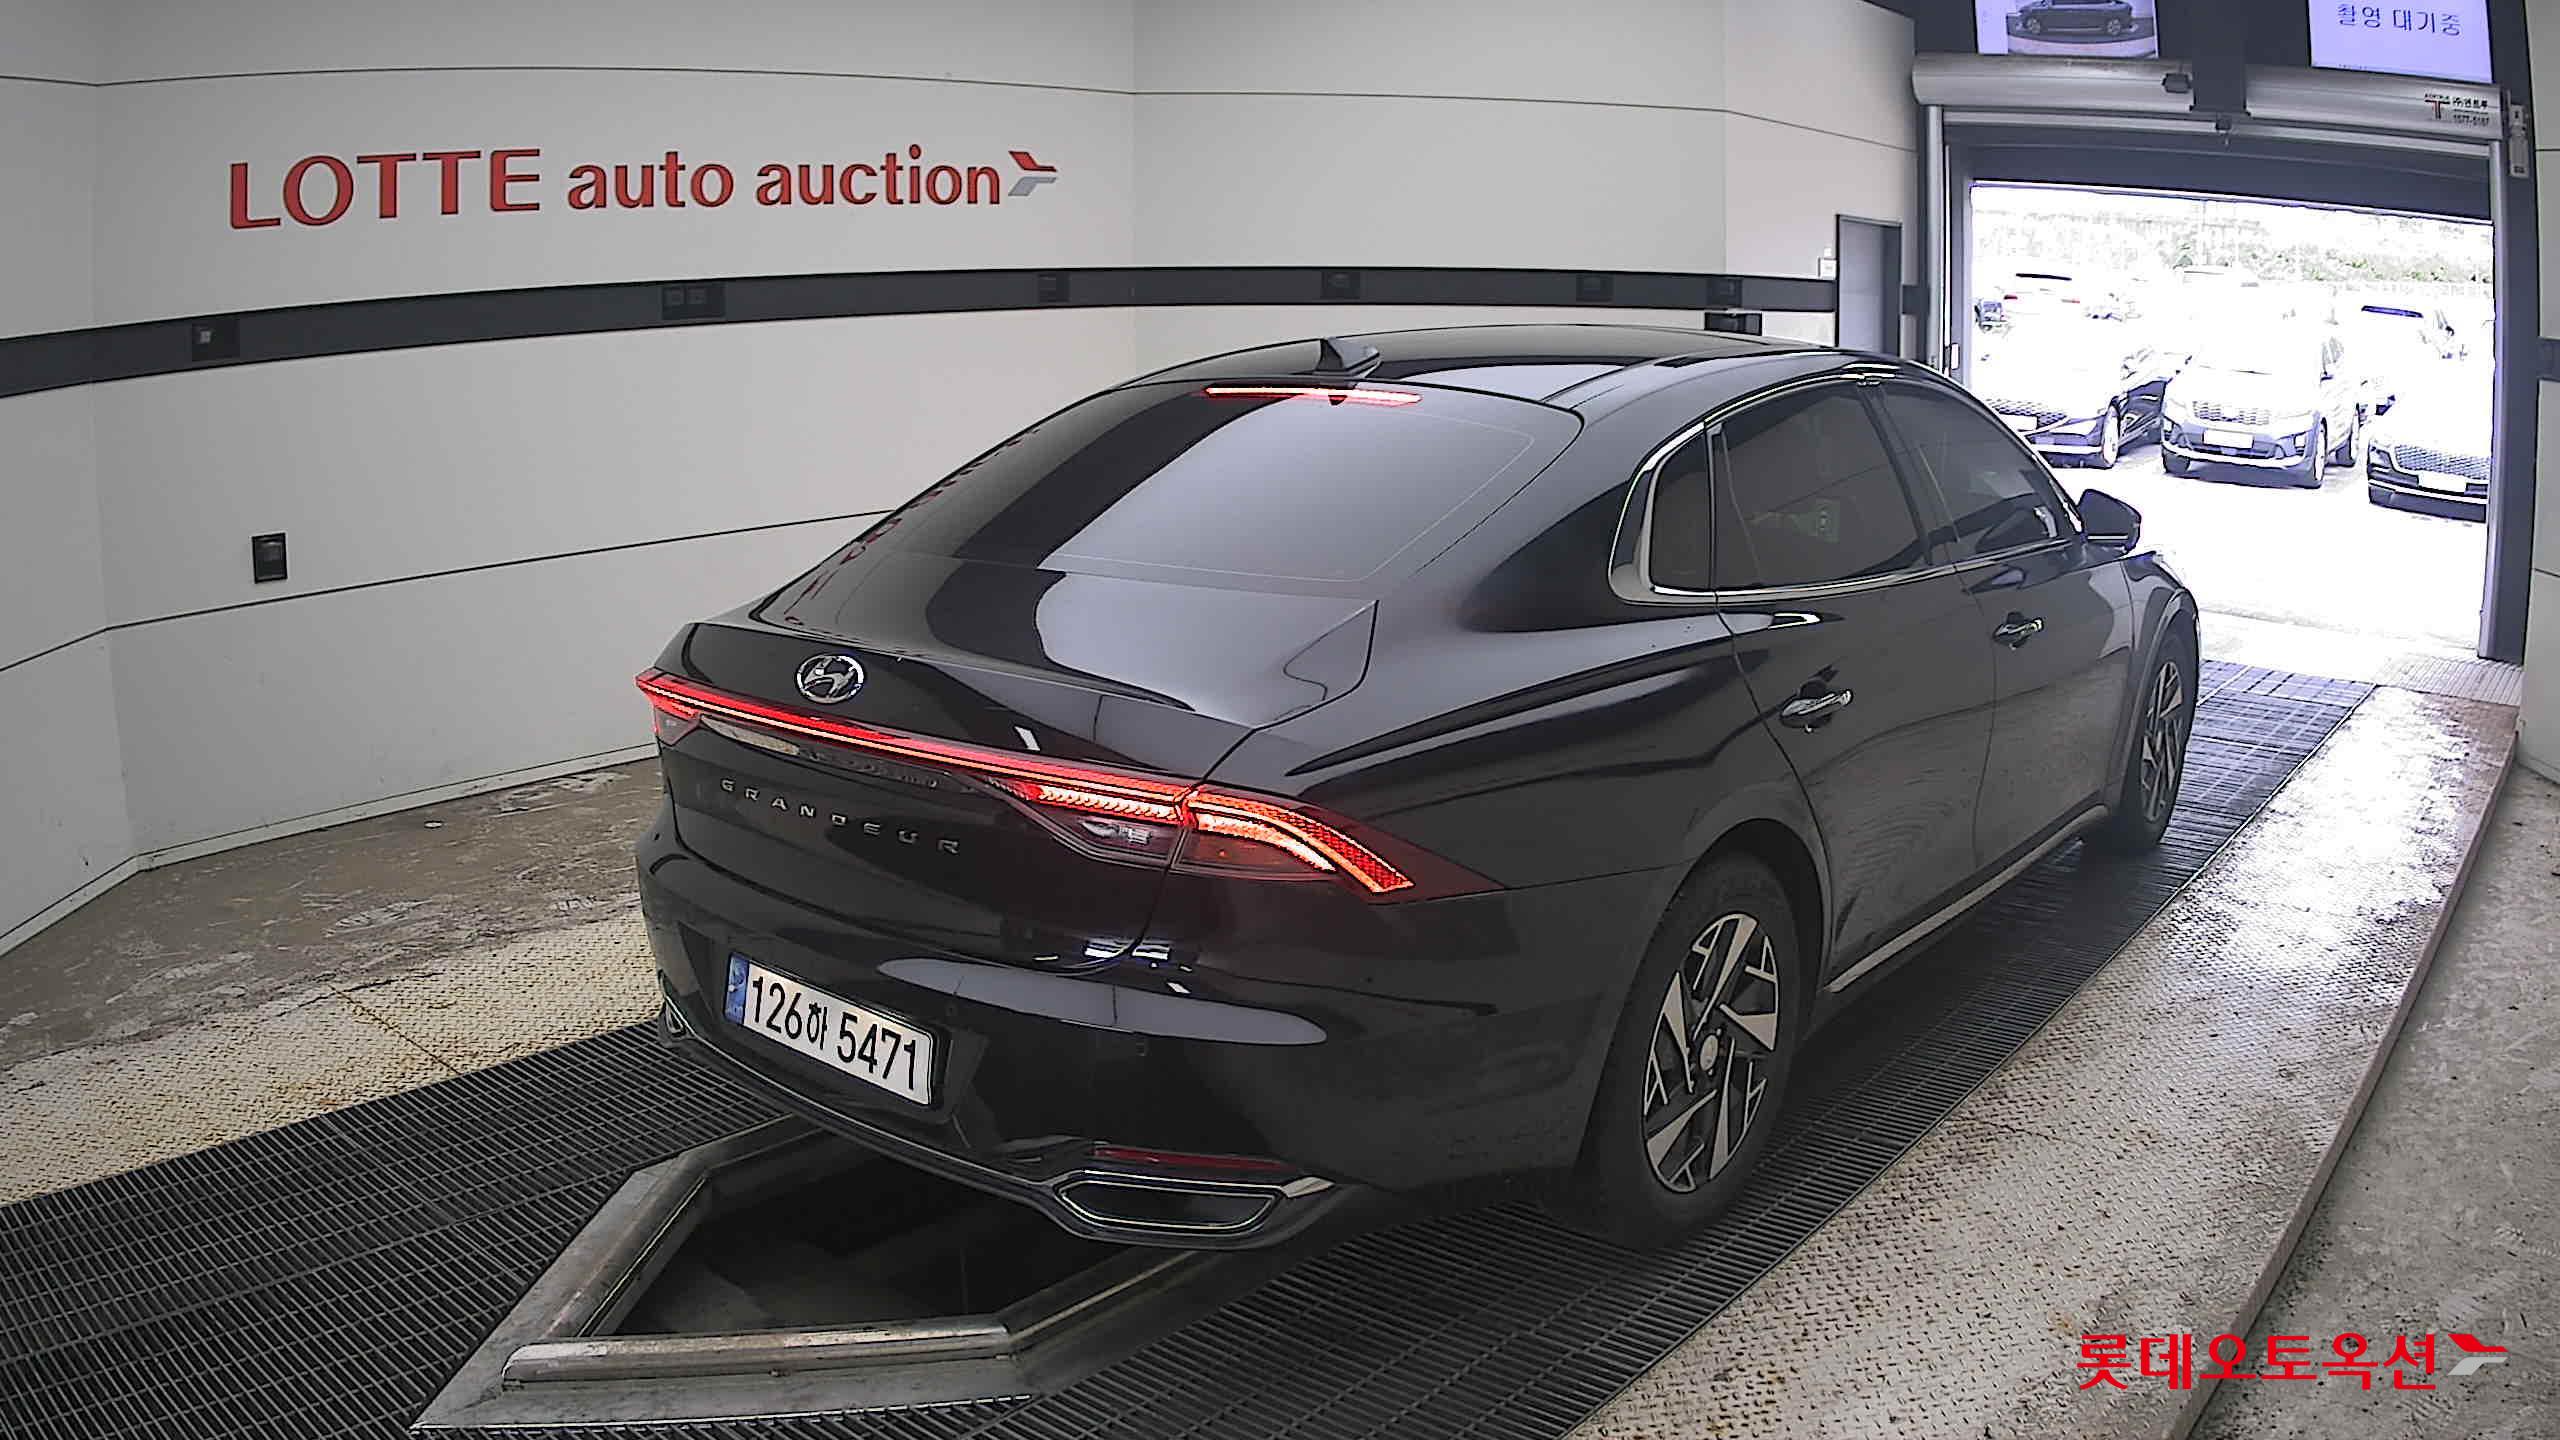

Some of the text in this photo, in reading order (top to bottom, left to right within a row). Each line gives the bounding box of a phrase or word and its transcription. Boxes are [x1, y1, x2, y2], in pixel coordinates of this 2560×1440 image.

[2337, 3, 2461, 37] 촬영 대기중
[230, 143, 1001, 230] LOTTE auto auction
[720, 777, 961, 855] GRANDEUR
[752, 975, 917, 1092] 126하 5471
